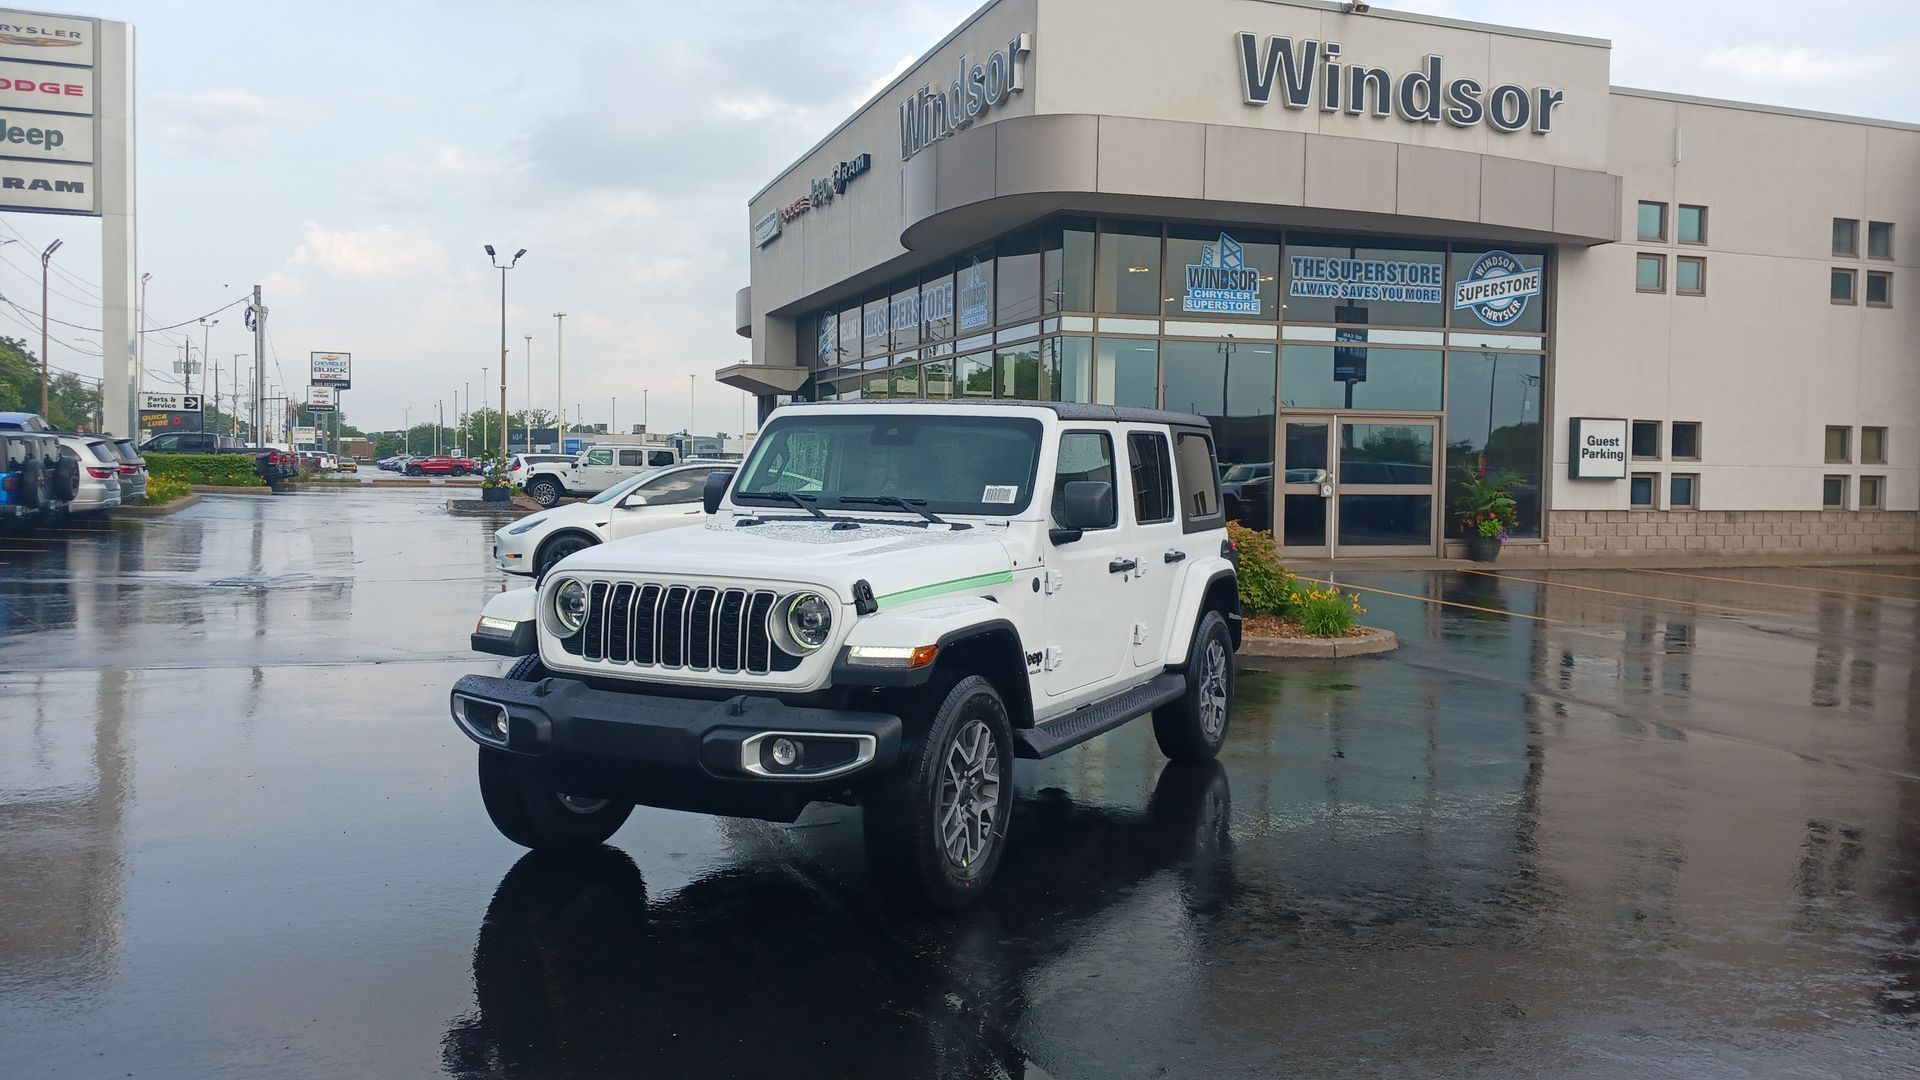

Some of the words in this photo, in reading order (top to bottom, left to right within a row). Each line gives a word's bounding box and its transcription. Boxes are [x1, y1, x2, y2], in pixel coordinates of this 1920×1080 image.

[1235, 31, 1565, 135] Windsor
[900, 33, 1032, 162] Windsor
[0, 118, 64, 150] Jeep
[2, 176, 84, 194] RAM
[780, 196, 810, 223] DODGE
[1291, 257, 1326, 279] THE
[1327, 258, 1442, 286] SUPERSTORE
[1475, 256, 1516, 276] WINDSOR
[1188, 267, 1257, 291] WINDSOR
[1458, 276, 1538, 302] SUPERSTORE
[1194, 290, 1250, 300] CHRYSLER
[1292, 281, 1338, 297] ALWAYS
[1341, 283, 1379, 299] SAVES
[1381, 286, 1403, 299] YOU
[1405, 287, 1441, 301] MORE!
[878, 282, 953, 336] SUPERSTORE
[1186, 299, 1258, 311] SUPERSTORE
[1481, 299, 1521, 322] CHRYSLER
[147, 395, 168, 403] Parts
[147, 401, 177, 409] Service
[142, 413, 169, 421] QUICK
[147, 419, 169, 427] LUBE
[1587, 435, 1620, 447] Guest
[1581, 447, 1624, 462] Parking
